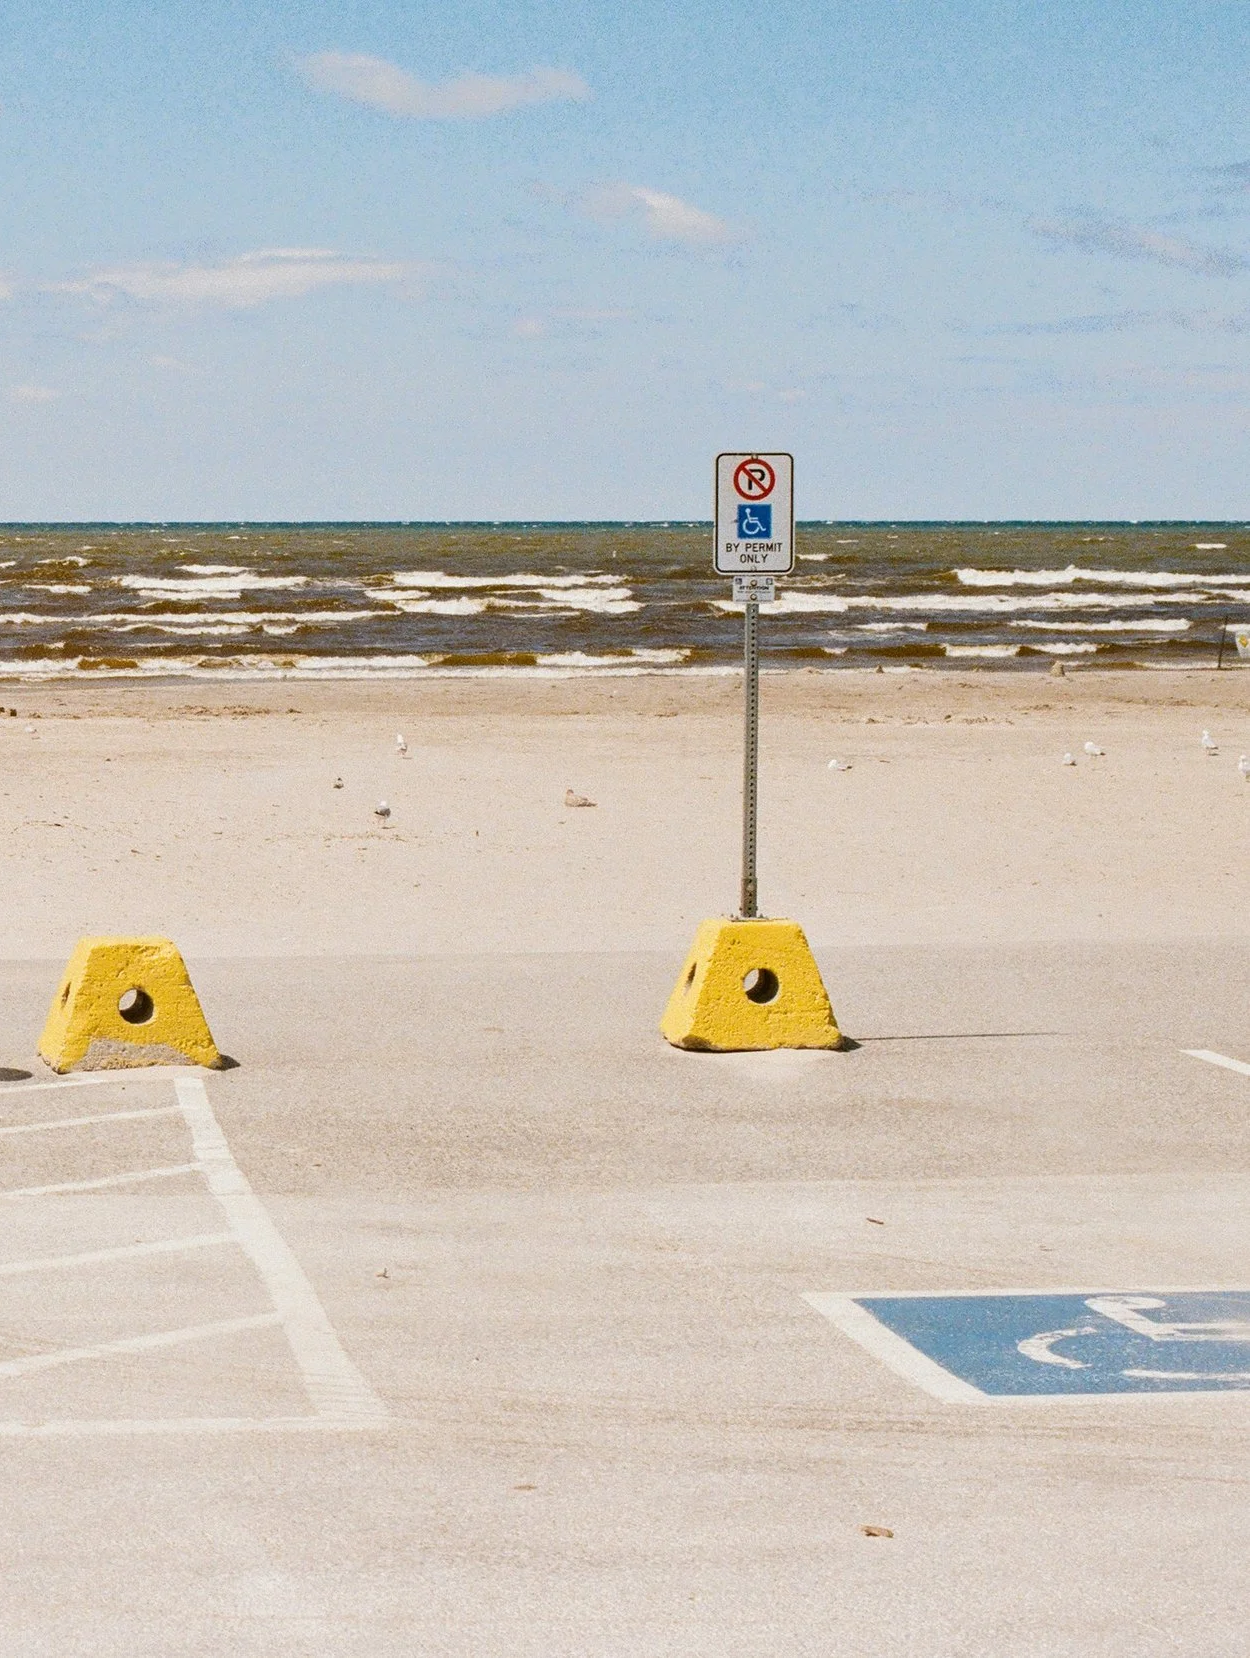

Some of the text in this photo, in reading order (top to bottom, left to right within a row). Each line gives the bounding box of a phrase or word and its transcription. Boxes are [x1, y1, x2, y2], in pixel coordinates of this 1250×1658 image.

[748, 469, 766, 490] P
[726, 543, 783, 553] BY PERMIT
[740, 554, 768, 564] ONLY
